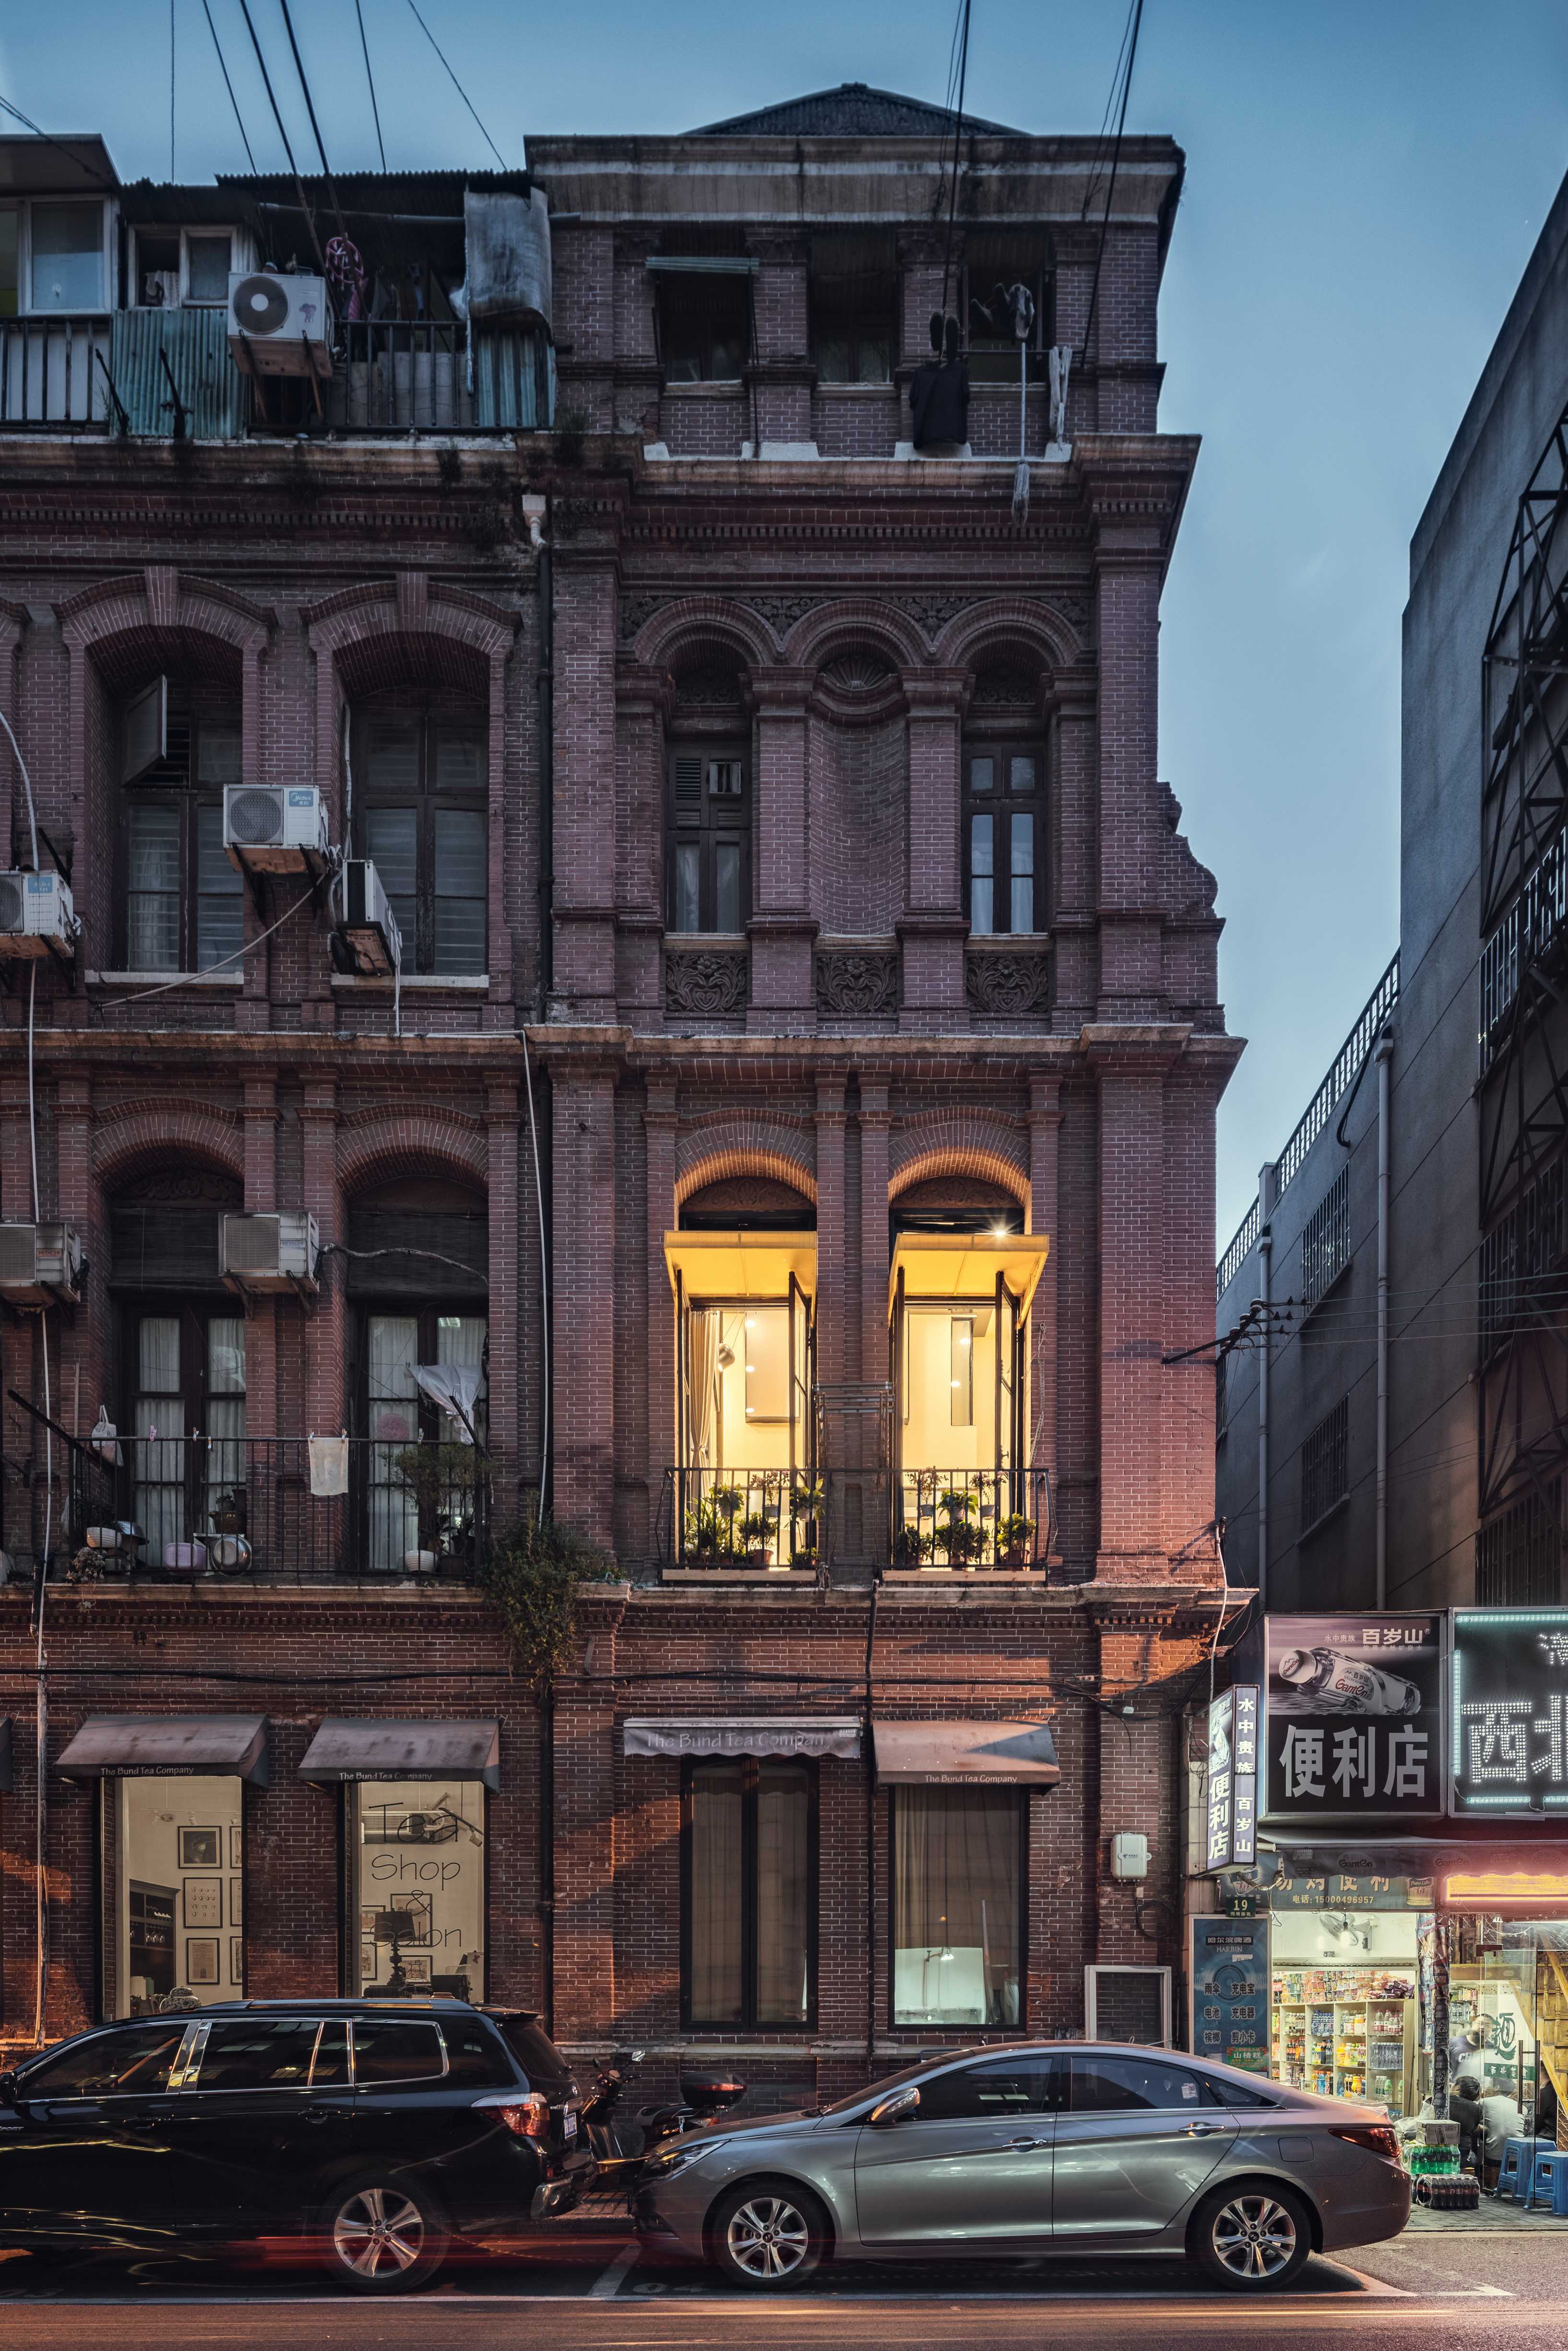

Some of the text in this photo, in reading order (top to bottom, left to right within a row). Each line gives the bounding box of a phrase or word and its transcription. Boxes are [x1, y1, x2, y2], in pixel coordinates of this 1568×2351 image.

[1324, 1635, 1355, 1643] 水中贵族
[1363, 1628, 1423, 1645] 百岁山
[1354, 1672, 1368, 1682] 百岁山
[647, 1732, 676, 1747] The
[679, 1733, 721, 1748] Bund
[725, 1733, 754, 1747] Tea
[1236, 1698, 1255, 1773] 水中贵族
[1279, 1724, 1428, 1797] 便利店
[156, 1766, 194, 1775] Company
[925, 1774, 1018, 1784] The Bund Tea Company
[368, 1802, 459, 1843] Tea
[1208, 1771, 1230, 1859] 便利店
[1236, 1797, 1253, 1852] 百岁山
[371, 1854, 461, 1890] Shop
[406, 1890, 432, 1915] &
[1234, 1900, 1247, 1911] 19
[369, 1921, 462, 1947] Salon
[1205, 1983, 1255, 1995] 雨伞 充电宝
[1205, 2007, 1255, 2019] 电池 充电器
[1204, 2030, 1255, 2043] 槟榔 剪小卡
